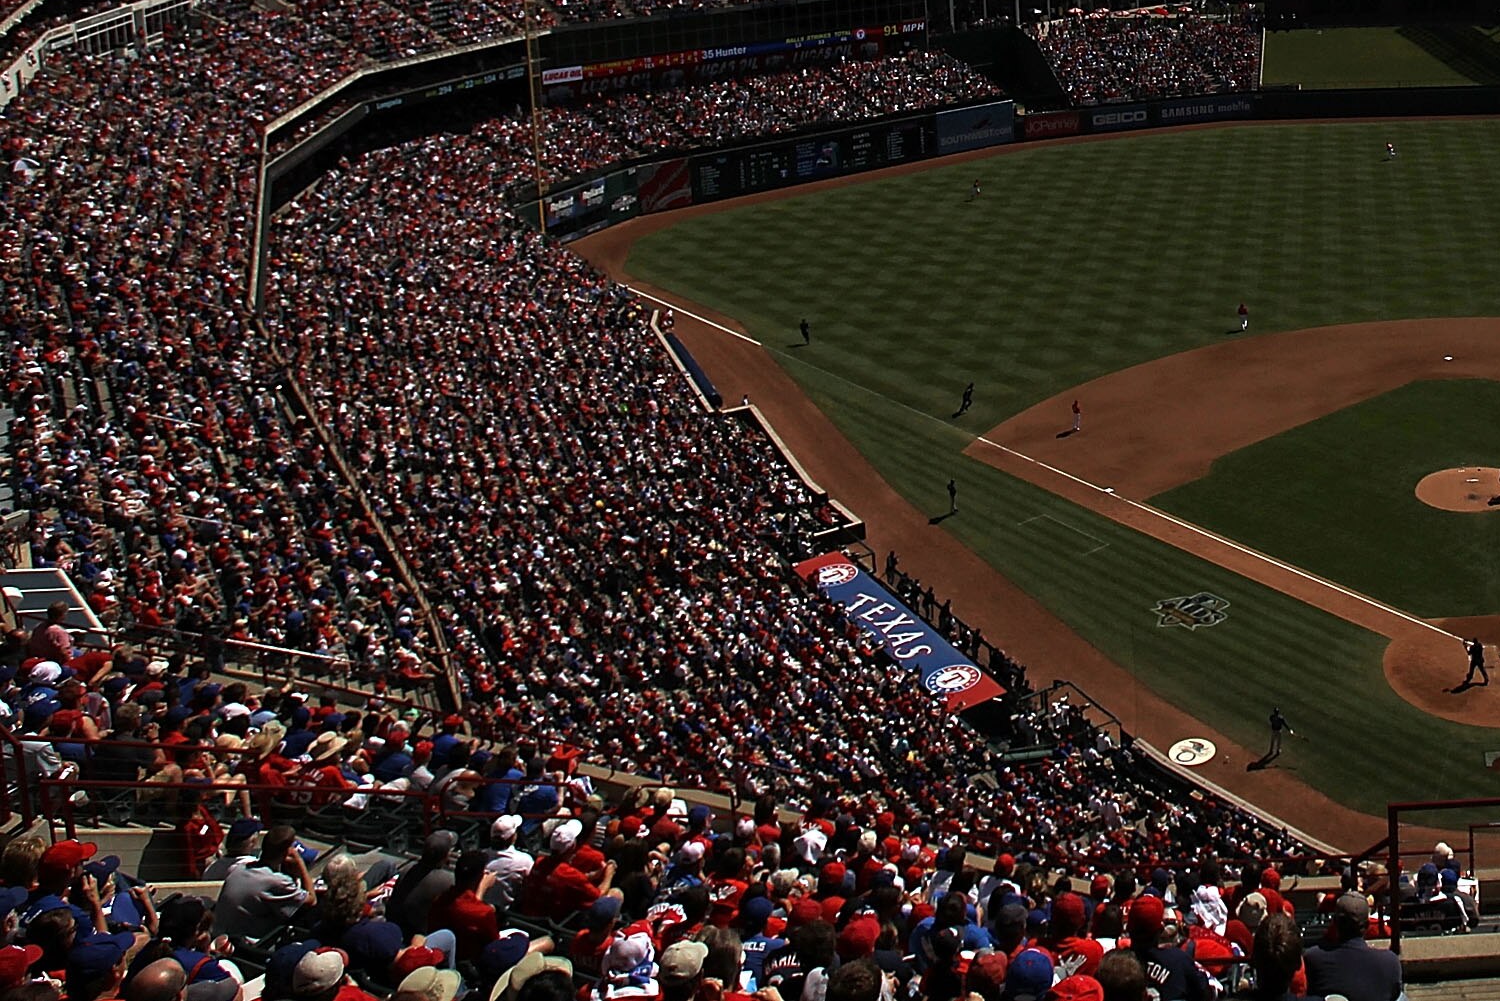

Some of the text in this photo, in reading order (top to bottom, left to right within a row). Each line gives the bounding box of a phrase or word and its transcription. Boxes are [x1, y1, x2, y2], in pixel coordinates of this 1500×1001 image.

[883, 25, 899, 36] 91
[902, 22, 925, 33] MPH
[702, 46, 747, 60] 35 Hunter
[543, 69, 583, 82] LUCAS OIL
[1161, 98, 1250, 119] SAMSUNG mobile
[1025, 118, 1079, 134] JCPenney
[1091, 109, 1147, 127] GEICO
[844, 592, 932, 659] TEXAS
[1147, 961, 1171, 985] TON
